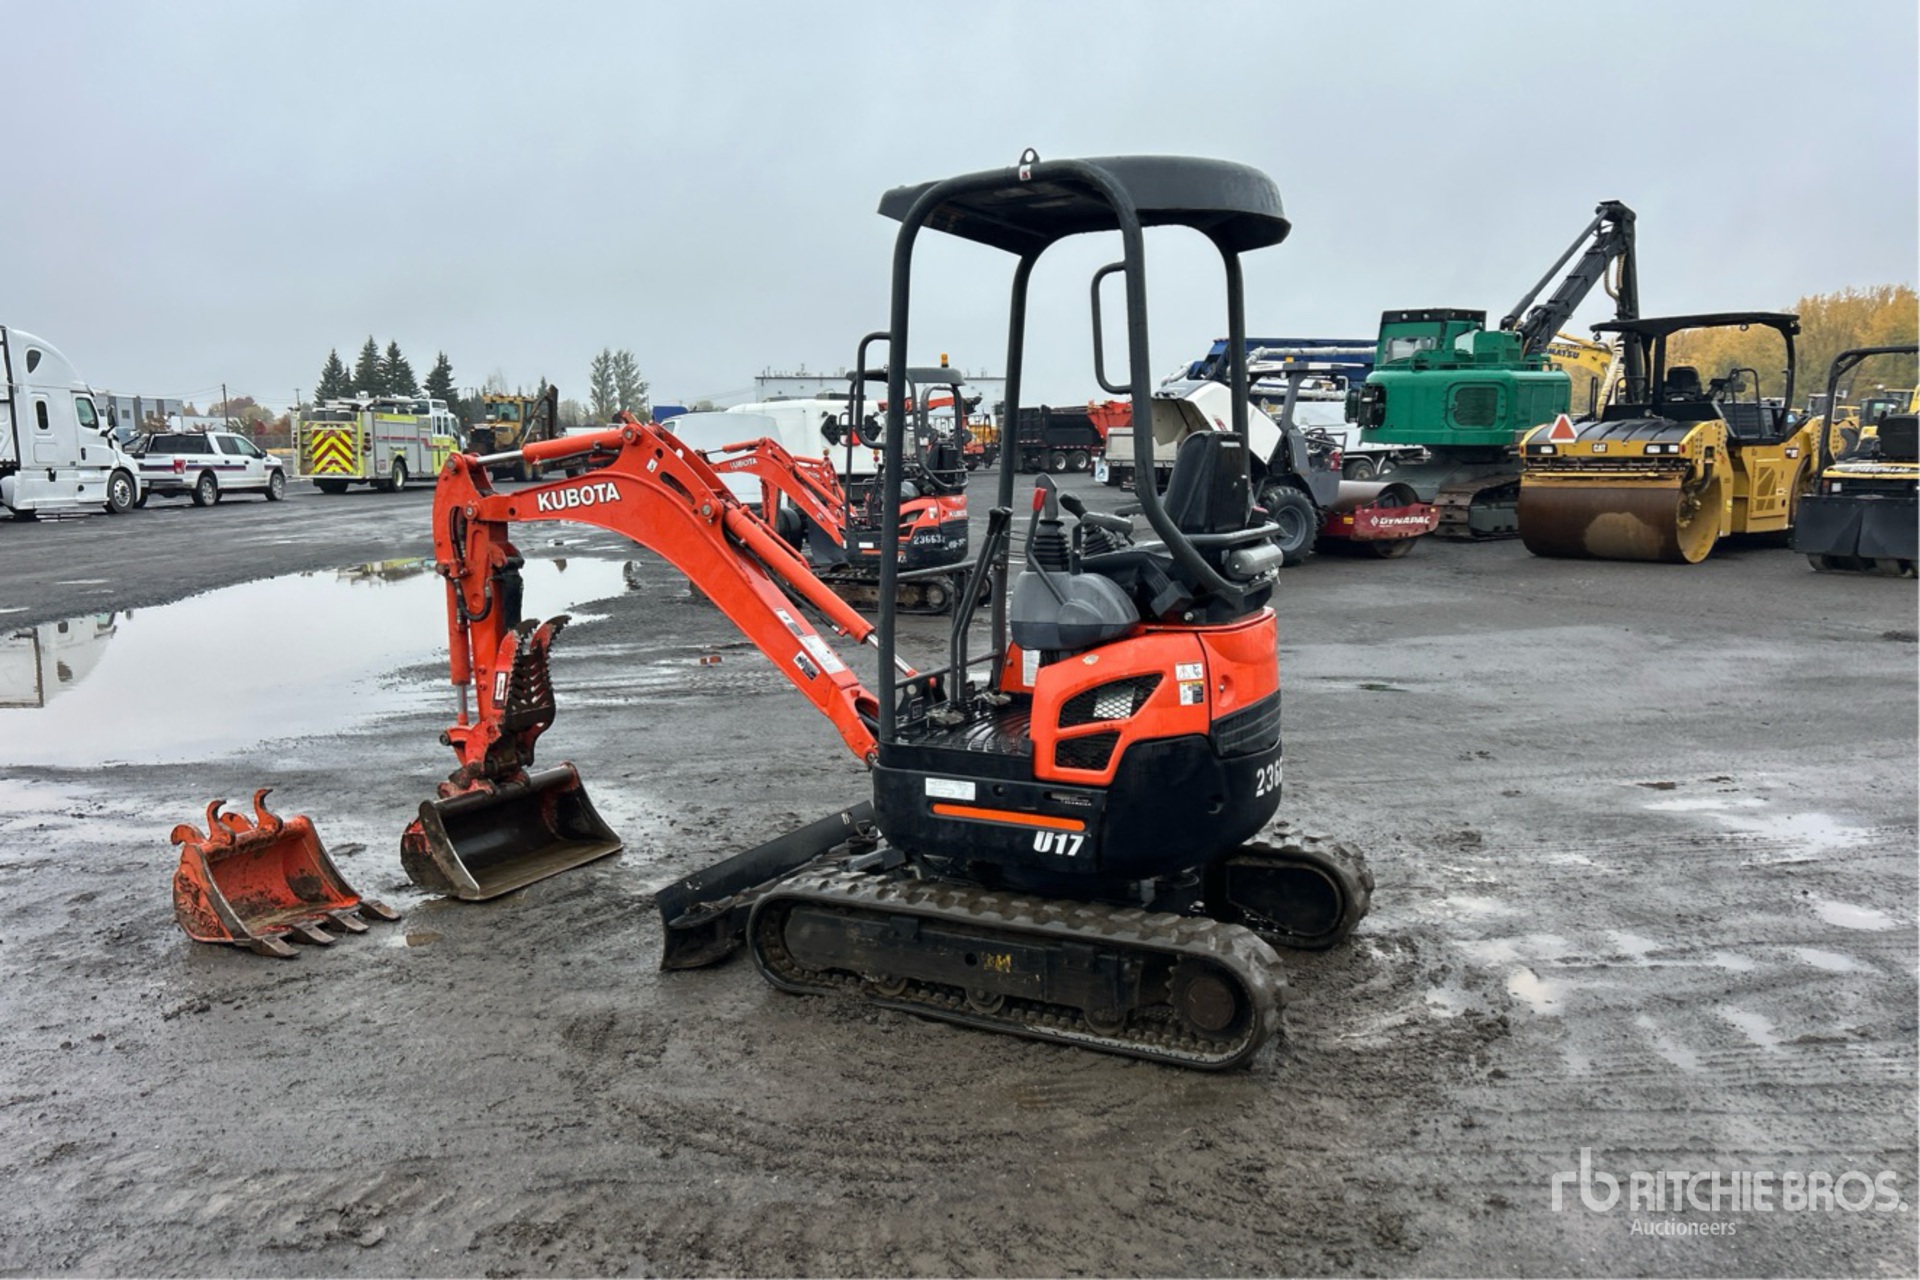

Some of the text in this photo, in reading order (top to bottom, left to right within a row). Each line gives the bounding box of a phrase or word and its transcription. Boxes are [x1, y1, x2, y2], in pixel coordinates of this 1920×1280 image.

[729, 458, 758, 469] KUBOTA
[536, 481, 622, 513] KUBOTA
[1379, 515, 1431, 526] DYNAPAC
[1256, 756, 1283, 797] 236
[1033, 830, 1085, 857] U17
